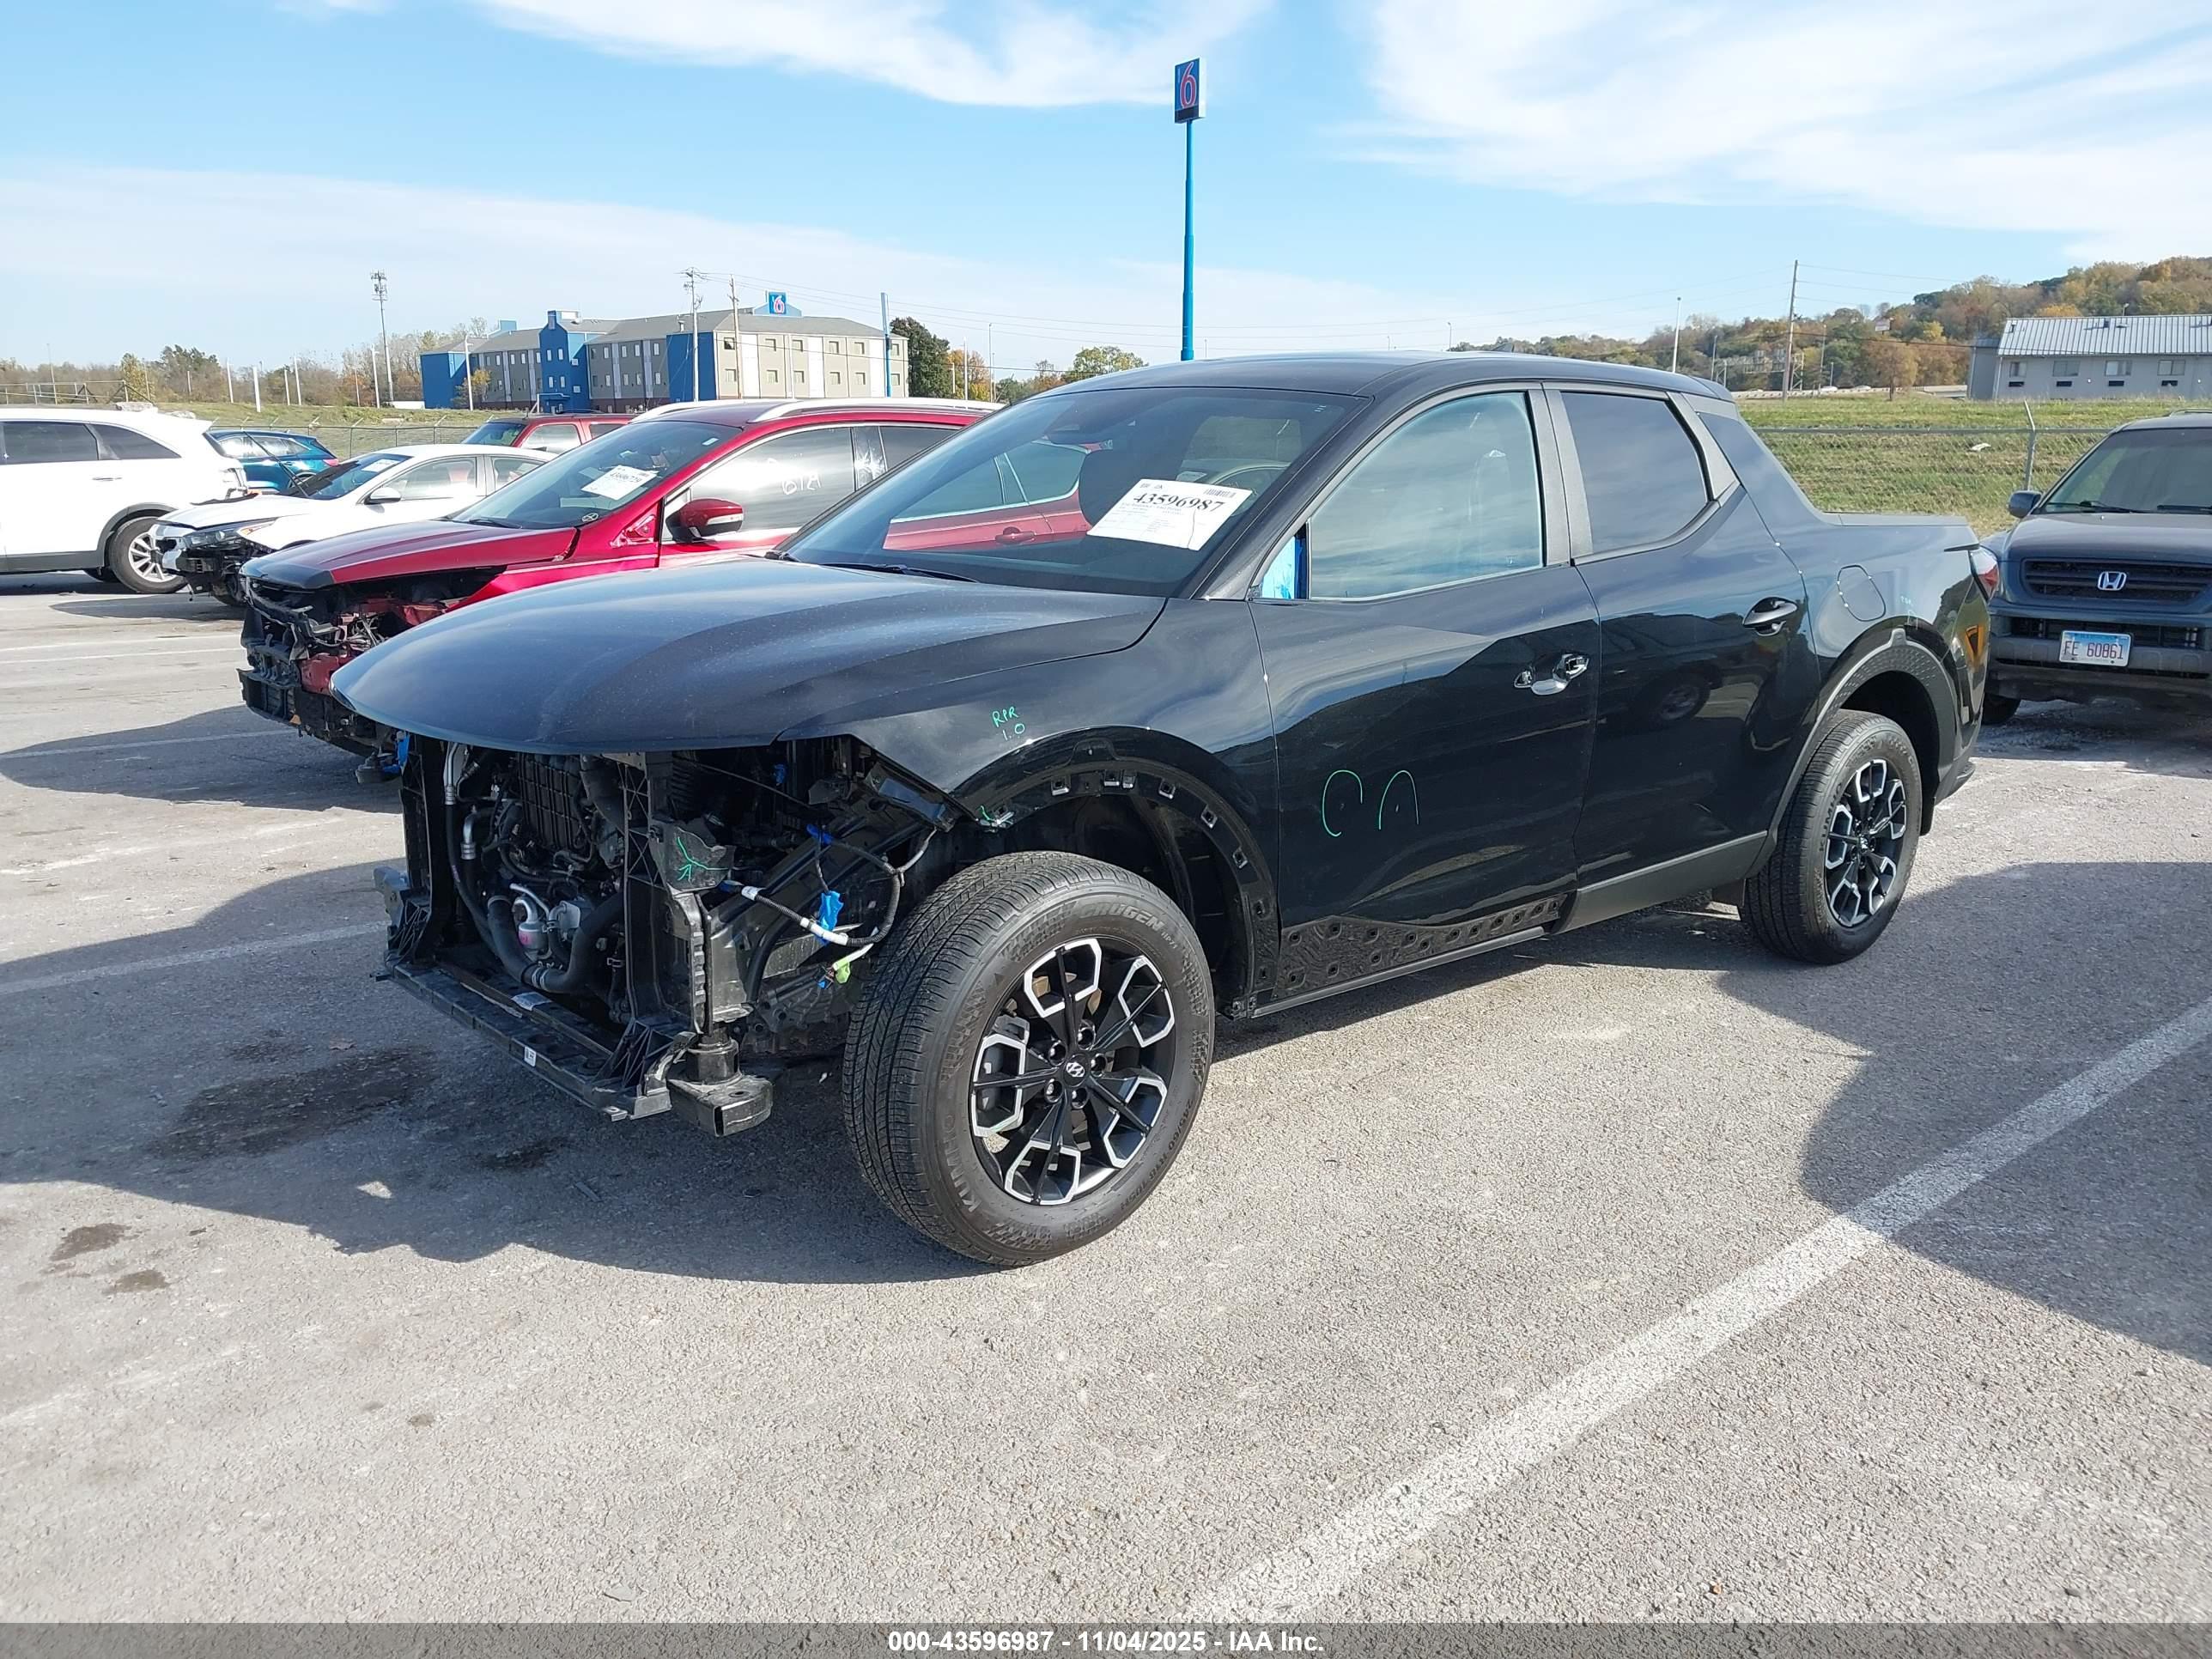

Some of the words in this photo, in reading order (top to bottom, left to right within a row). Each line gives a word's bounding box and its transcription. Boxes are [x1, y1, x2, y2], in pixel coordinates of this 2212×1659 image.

[1179, 61, 1197, 109] 6
[773, 295, 785, 313] 6
[1133, 492, 1226, 513] 43596987
[2063, 641, 2080, 656] FE
[2087, 642, 2124, 660] 60861
